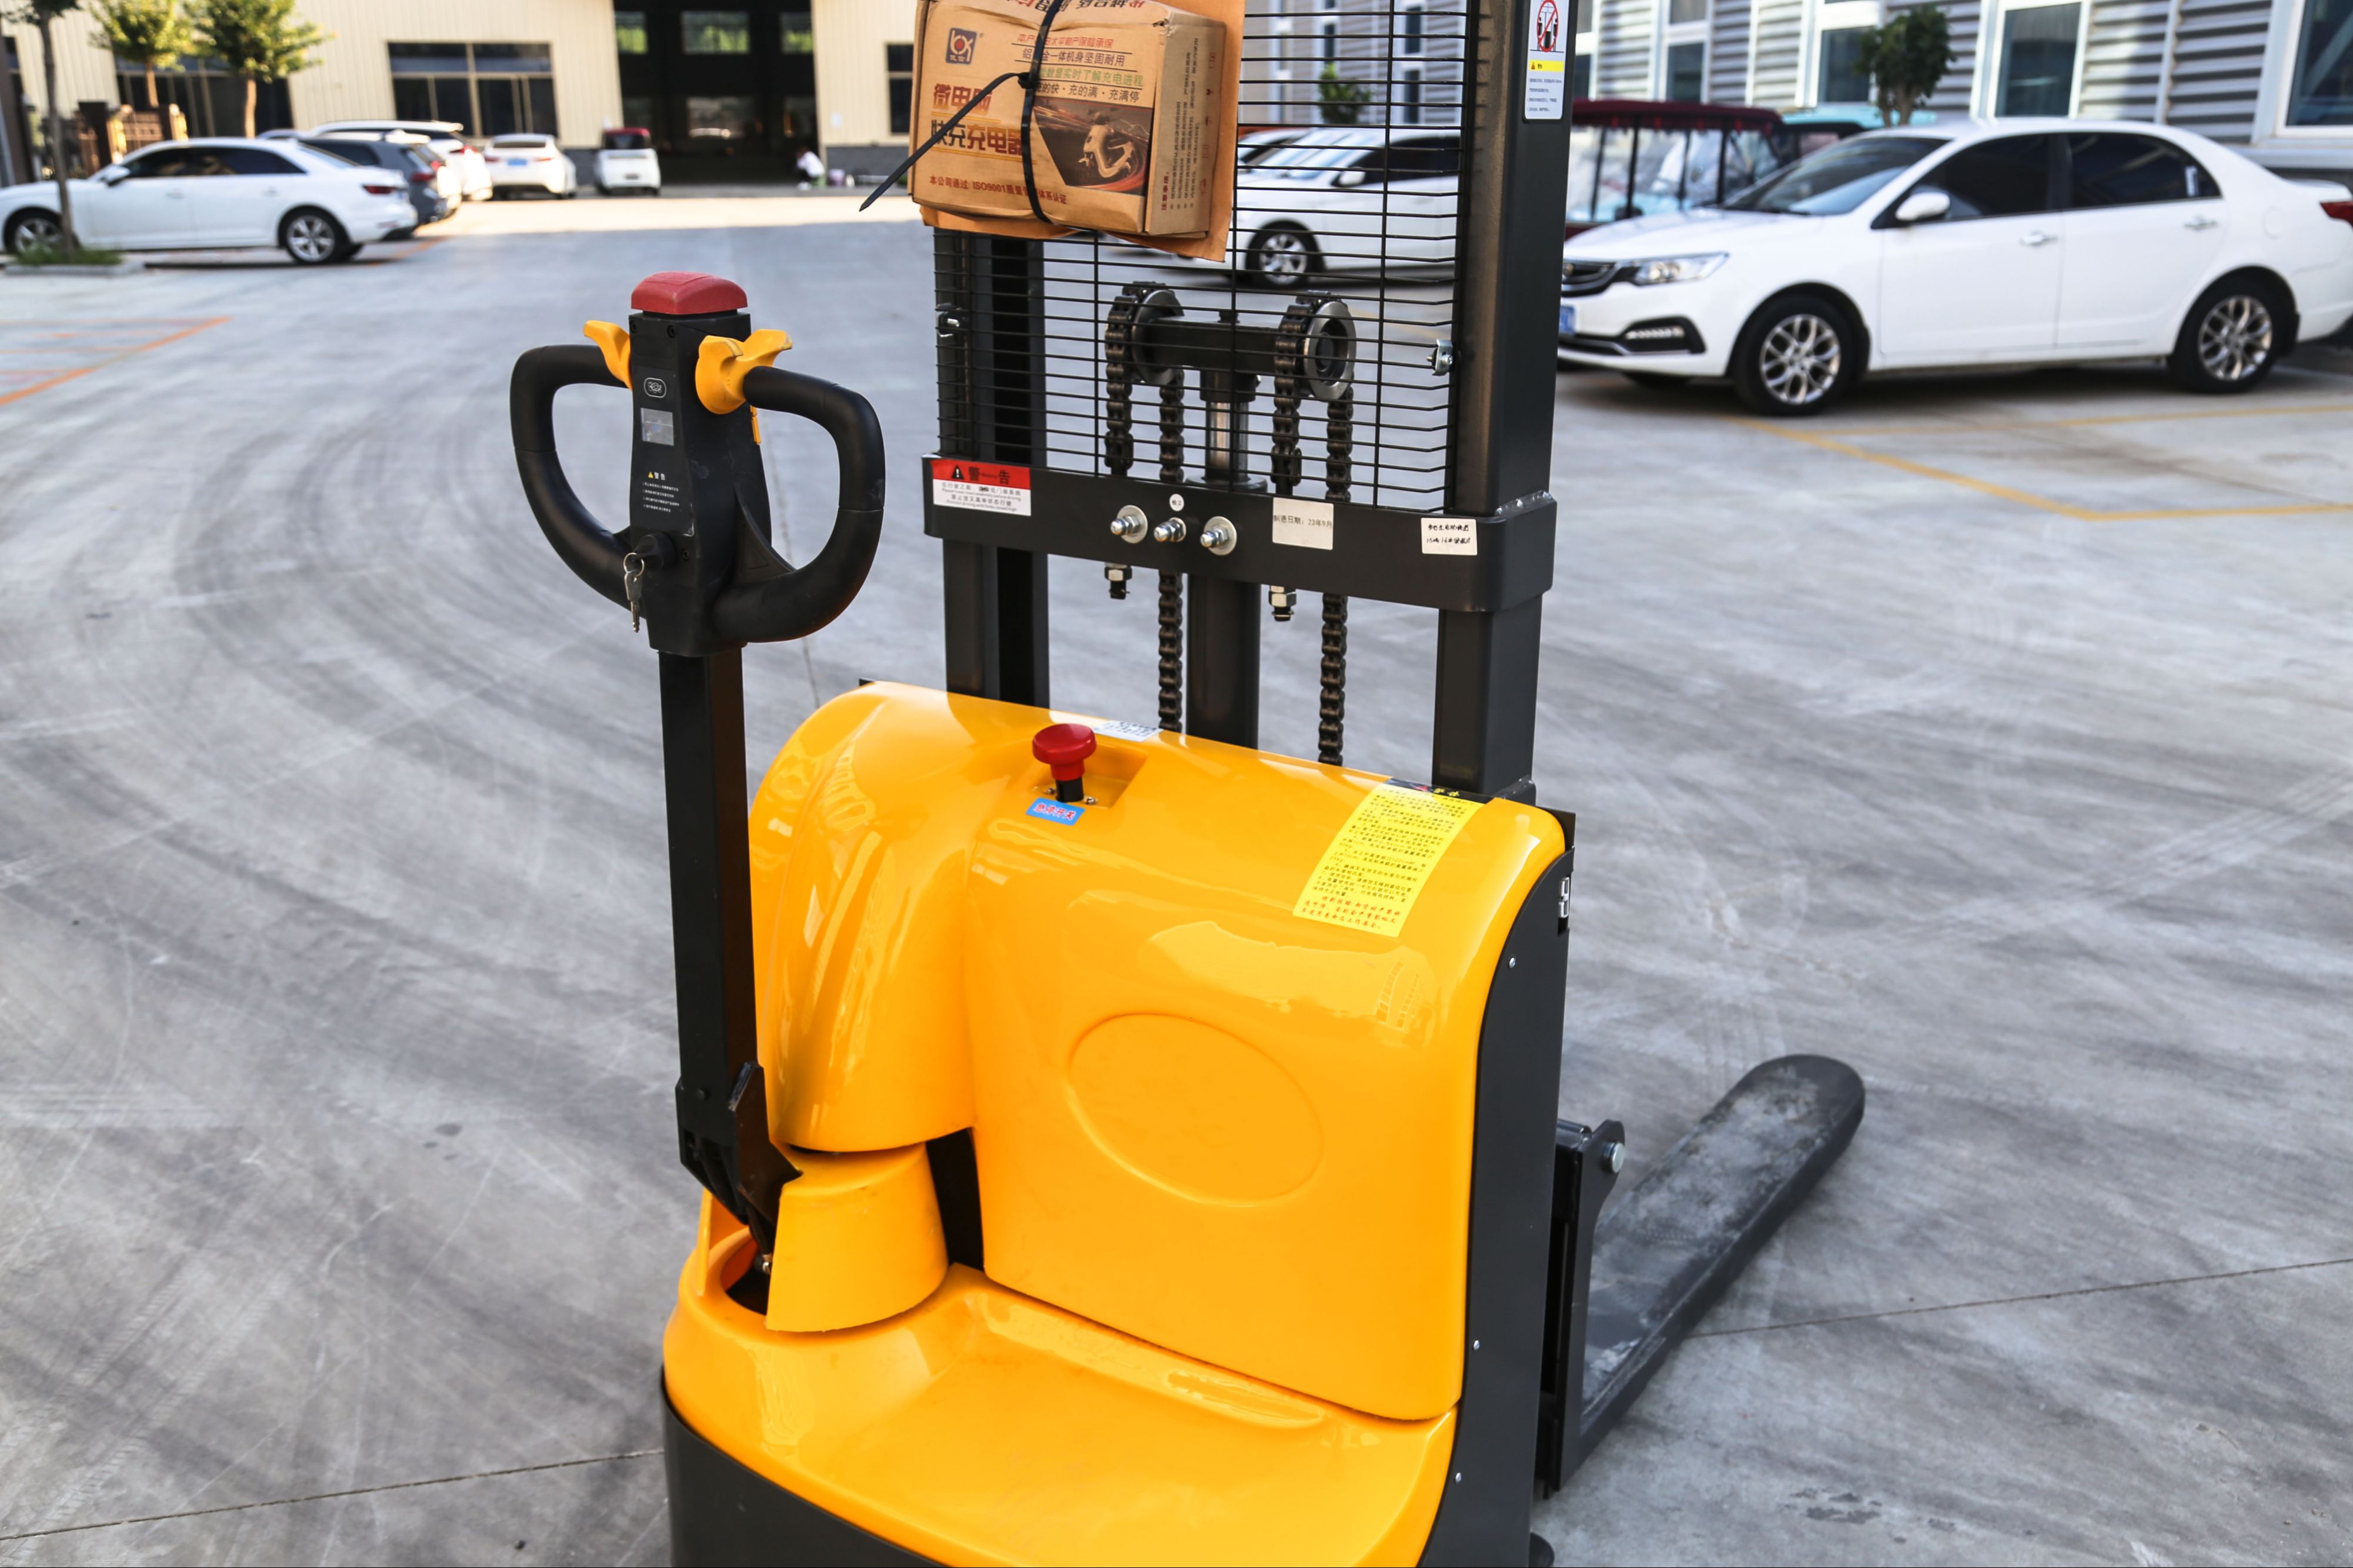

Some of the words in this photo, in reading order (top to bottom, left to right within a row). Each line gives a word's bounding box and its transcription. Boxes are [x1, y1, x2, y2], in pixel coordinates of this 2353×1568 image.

[1023, 48, 1125, 66] 铝金一体机身坚固耐用
